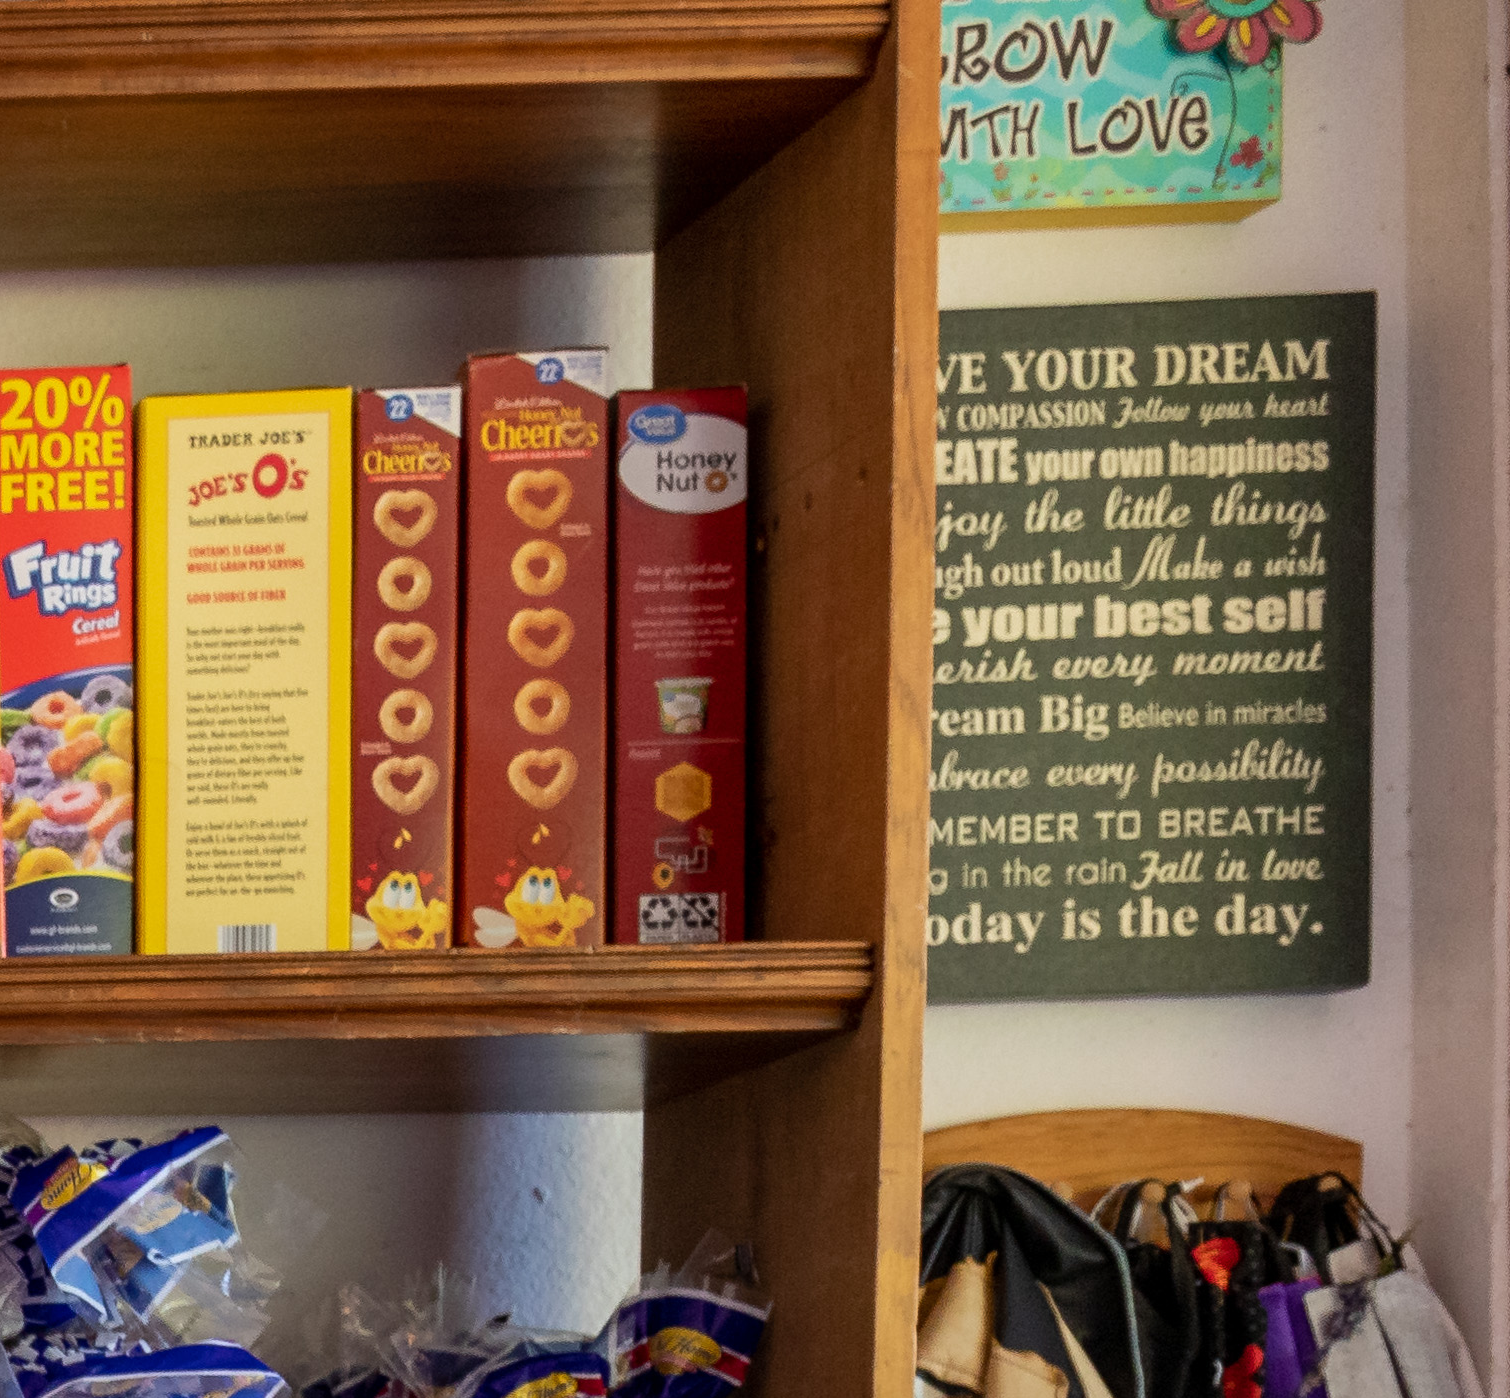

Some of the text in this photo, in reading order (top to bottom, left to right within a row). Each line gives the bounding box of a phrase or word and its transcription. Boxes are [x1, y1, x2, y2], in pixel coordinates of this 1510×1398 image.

[1003, 338, 1331, 393] YOUR DREAM
[0, 377, 126, 432] 20%
[956, 400, 1106, 432] COMPASSION
[1199, 403, 1254, 427] your
[1265, 393, 1331, 418] heart
[0, 430, 125, 472] MORE
[189, 430, 306, 449] TRADER JOE'S
[656, 449, 737, 472] Honey
[1025, 438, 1330, 486] your own happiness
[0, 473, 125, 514] FREE!
[656, 472, 698, 492] Nut
[1024, 481, 1329, 540] the little things
[9, 540, 118, 593] Fruit
[990, 531, 1326, 586] out loud a wish
[43, 581, 116, 614] Rings
[961, 588, 1326, 647] your best self
[72, 610, 121, 635] Cereal
[1052, 641, 1326, 687] every moment
[1039, 694, 1327, 741] Big Believe in miracles
[1045, 738, 1325, 799] every possibility
[1093, 805, 1325, 840] TO BREATHE
[962, 863, 988, 888] in
[1003, 856, 1052, 888] the
[1065, 858, 1127, 886] rain
[1261, 848, 1323, 881] love
[1062, 892, 1324, 946] is the day.
